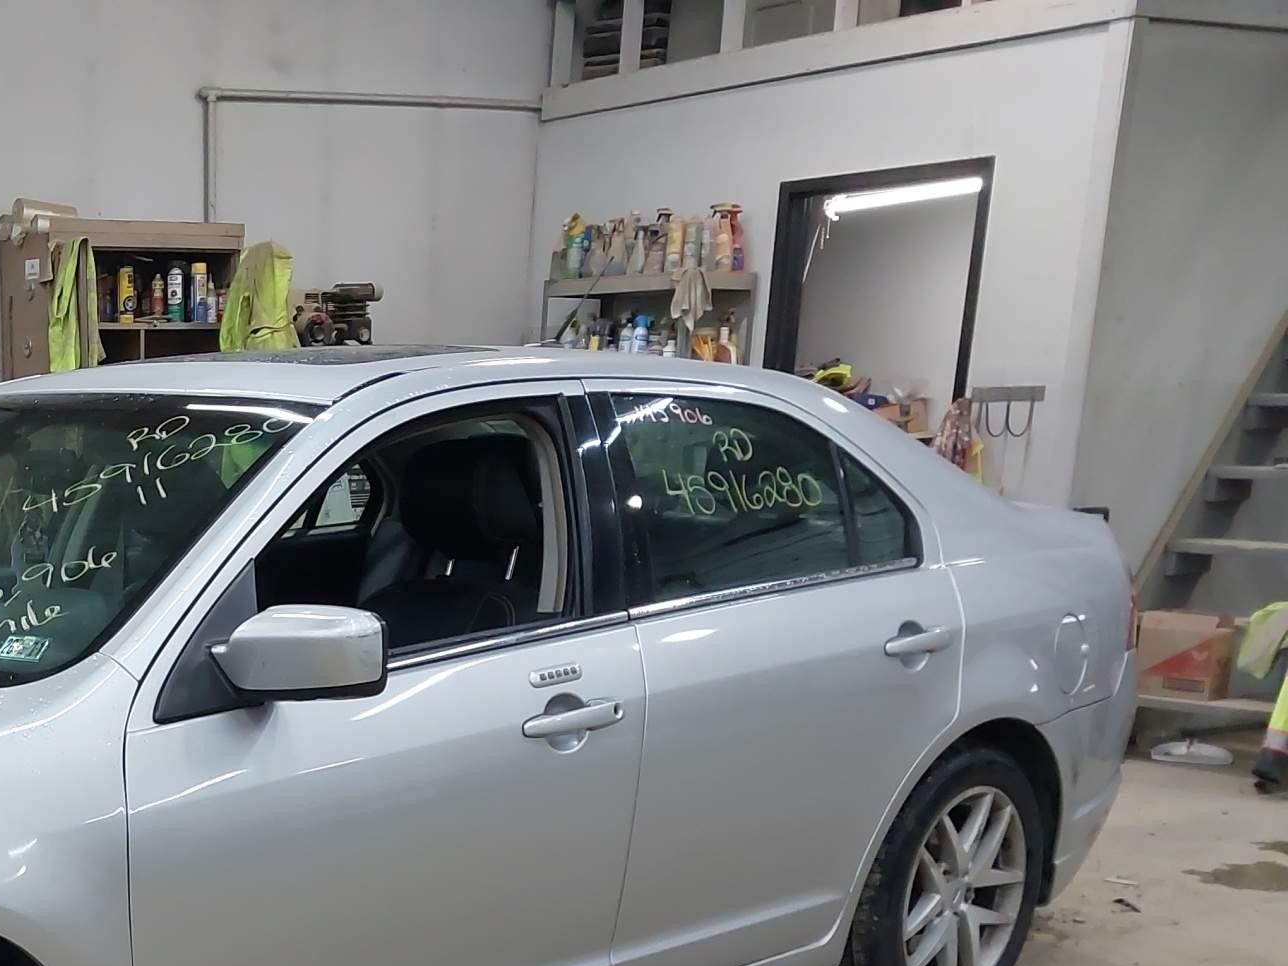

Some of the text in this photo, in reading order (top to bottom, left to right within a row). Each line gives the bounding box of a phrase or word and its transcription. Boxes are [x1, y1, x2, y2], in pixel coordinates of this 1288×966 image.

[125, 415, 190, 451] RD
[712, 427, 754, 463] RD
[22, 416, 294, 513] 45916280
[661, 466, 824, 516] 45916280
